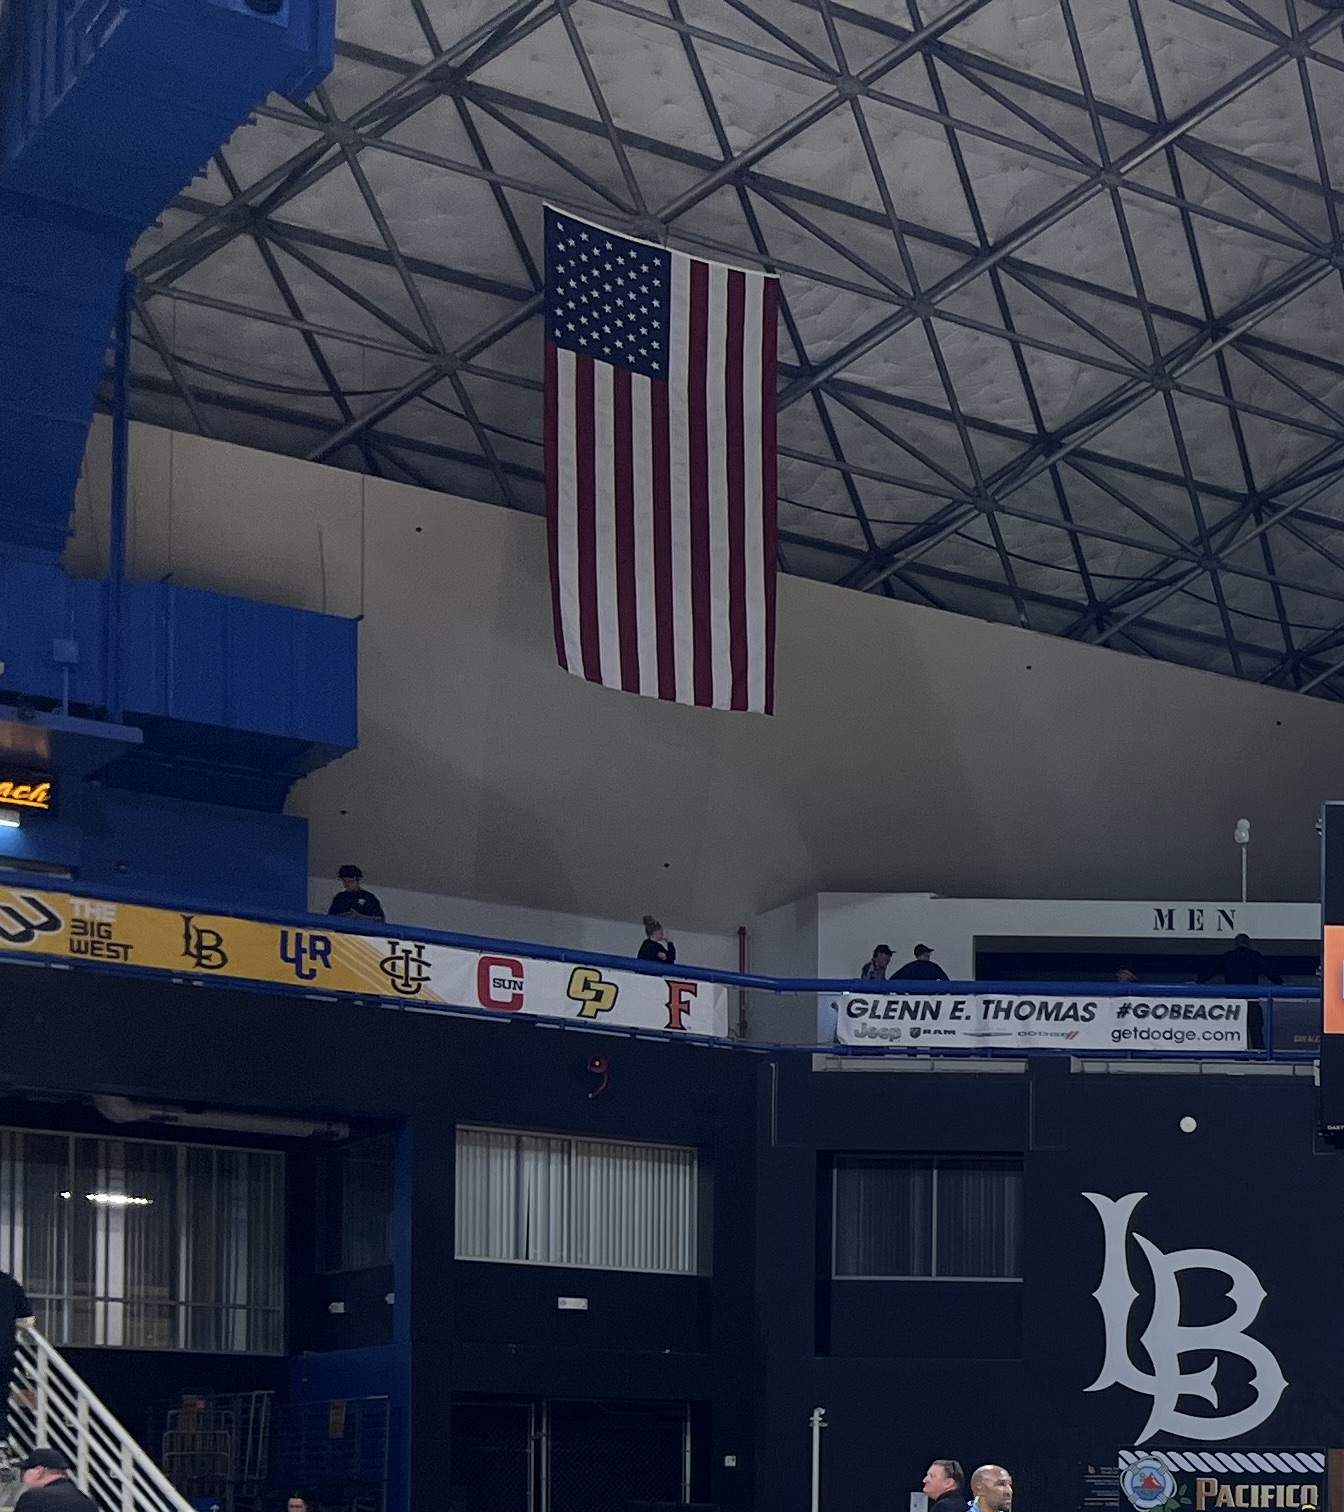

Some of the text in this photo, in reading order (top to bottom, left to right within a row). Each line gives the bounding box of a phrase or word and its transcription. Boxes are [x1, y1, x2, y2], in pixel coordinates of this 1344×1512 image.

[69, 898, 117, 922] THE
[1153, 908, 1236, 931] MEN
[70, 938, 134, 961] WEST
[664, 979, 698, 1030] F
[846, 997, 1241, 1023] GLENN E. THOMAS #GOBEACH
[853, 1023, 901, 1042] Jeep
[1111, 1026, 1241, 1043] getdodge.com
[1081, 1191, 1289, 1445] LB
[1195, 1477, 1319, 1511] PACIFICO
